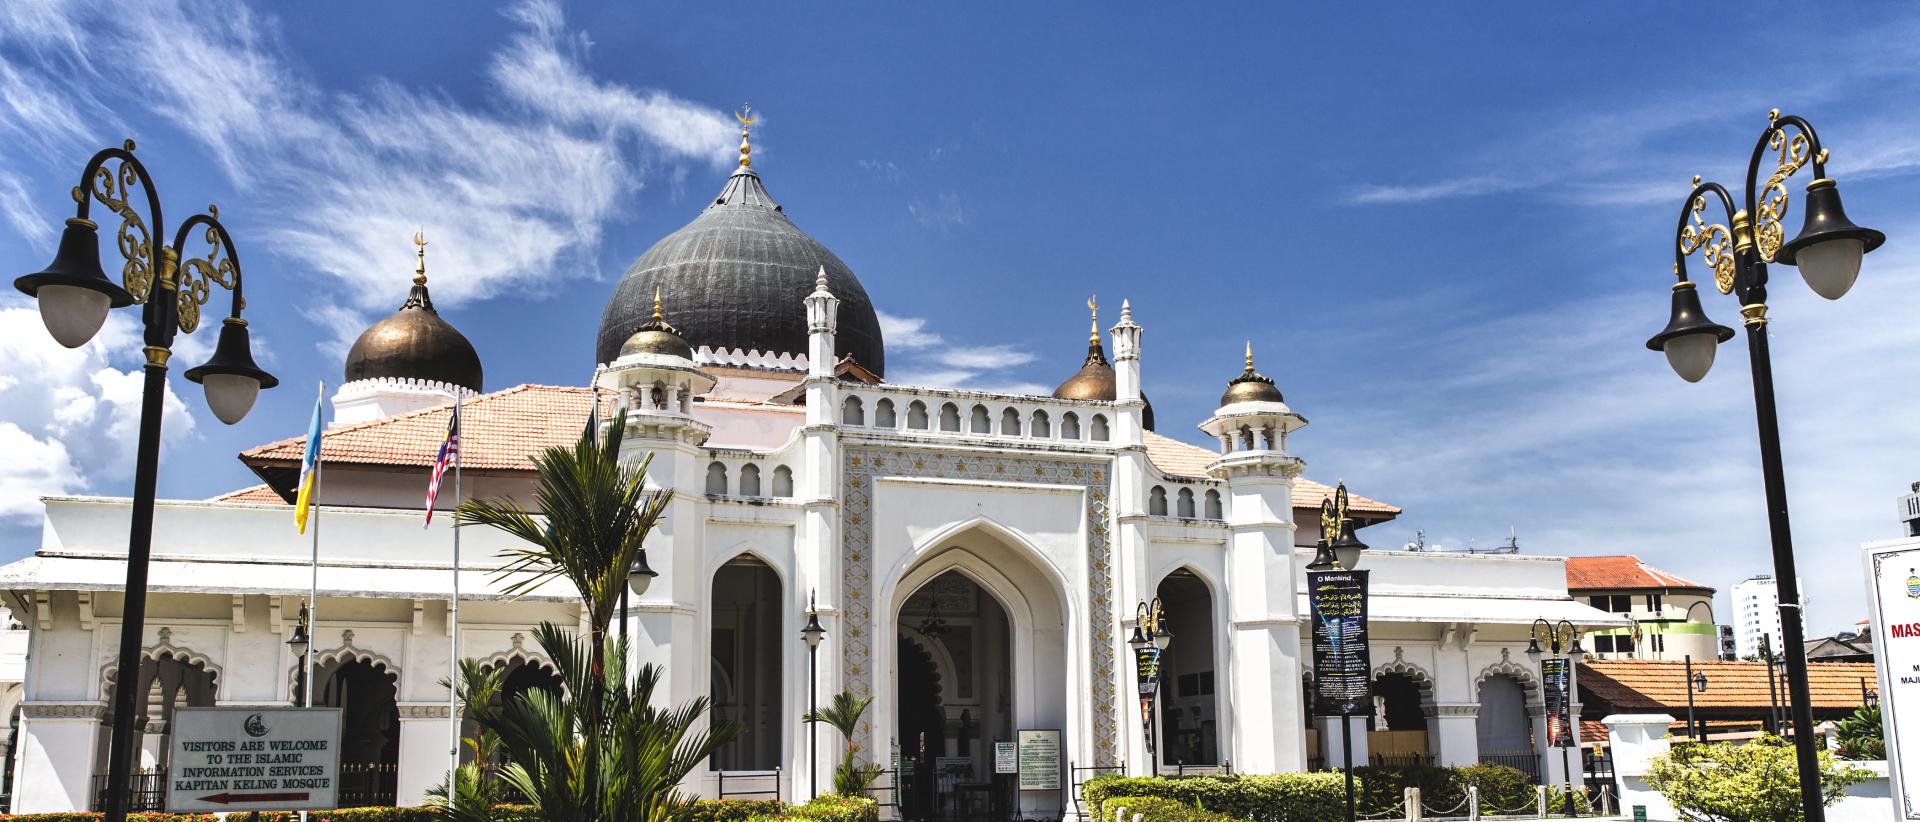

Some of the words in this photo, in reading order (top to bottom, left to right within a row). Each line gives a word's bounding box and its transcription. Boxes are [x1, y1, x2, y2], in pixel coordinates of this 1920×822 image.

[182, 741, 236, 752] VISITORS
[239, 741, 265, 751] ARE
[269, 740, 328, 751] WELCOME
[206, 754, 223, 765] TO
[227, 754, 251, 764] THE
[255, 753, 303, 764] ISLAMIC
[183, 766, 266, 778] INFORMATION
[269, 765, 324, 776] SERVICES
[175, 780, 229, 791] KAPITAN
[233, 779, 278, 790] KELING
[282, 778, 330, 789] MOSQUE
